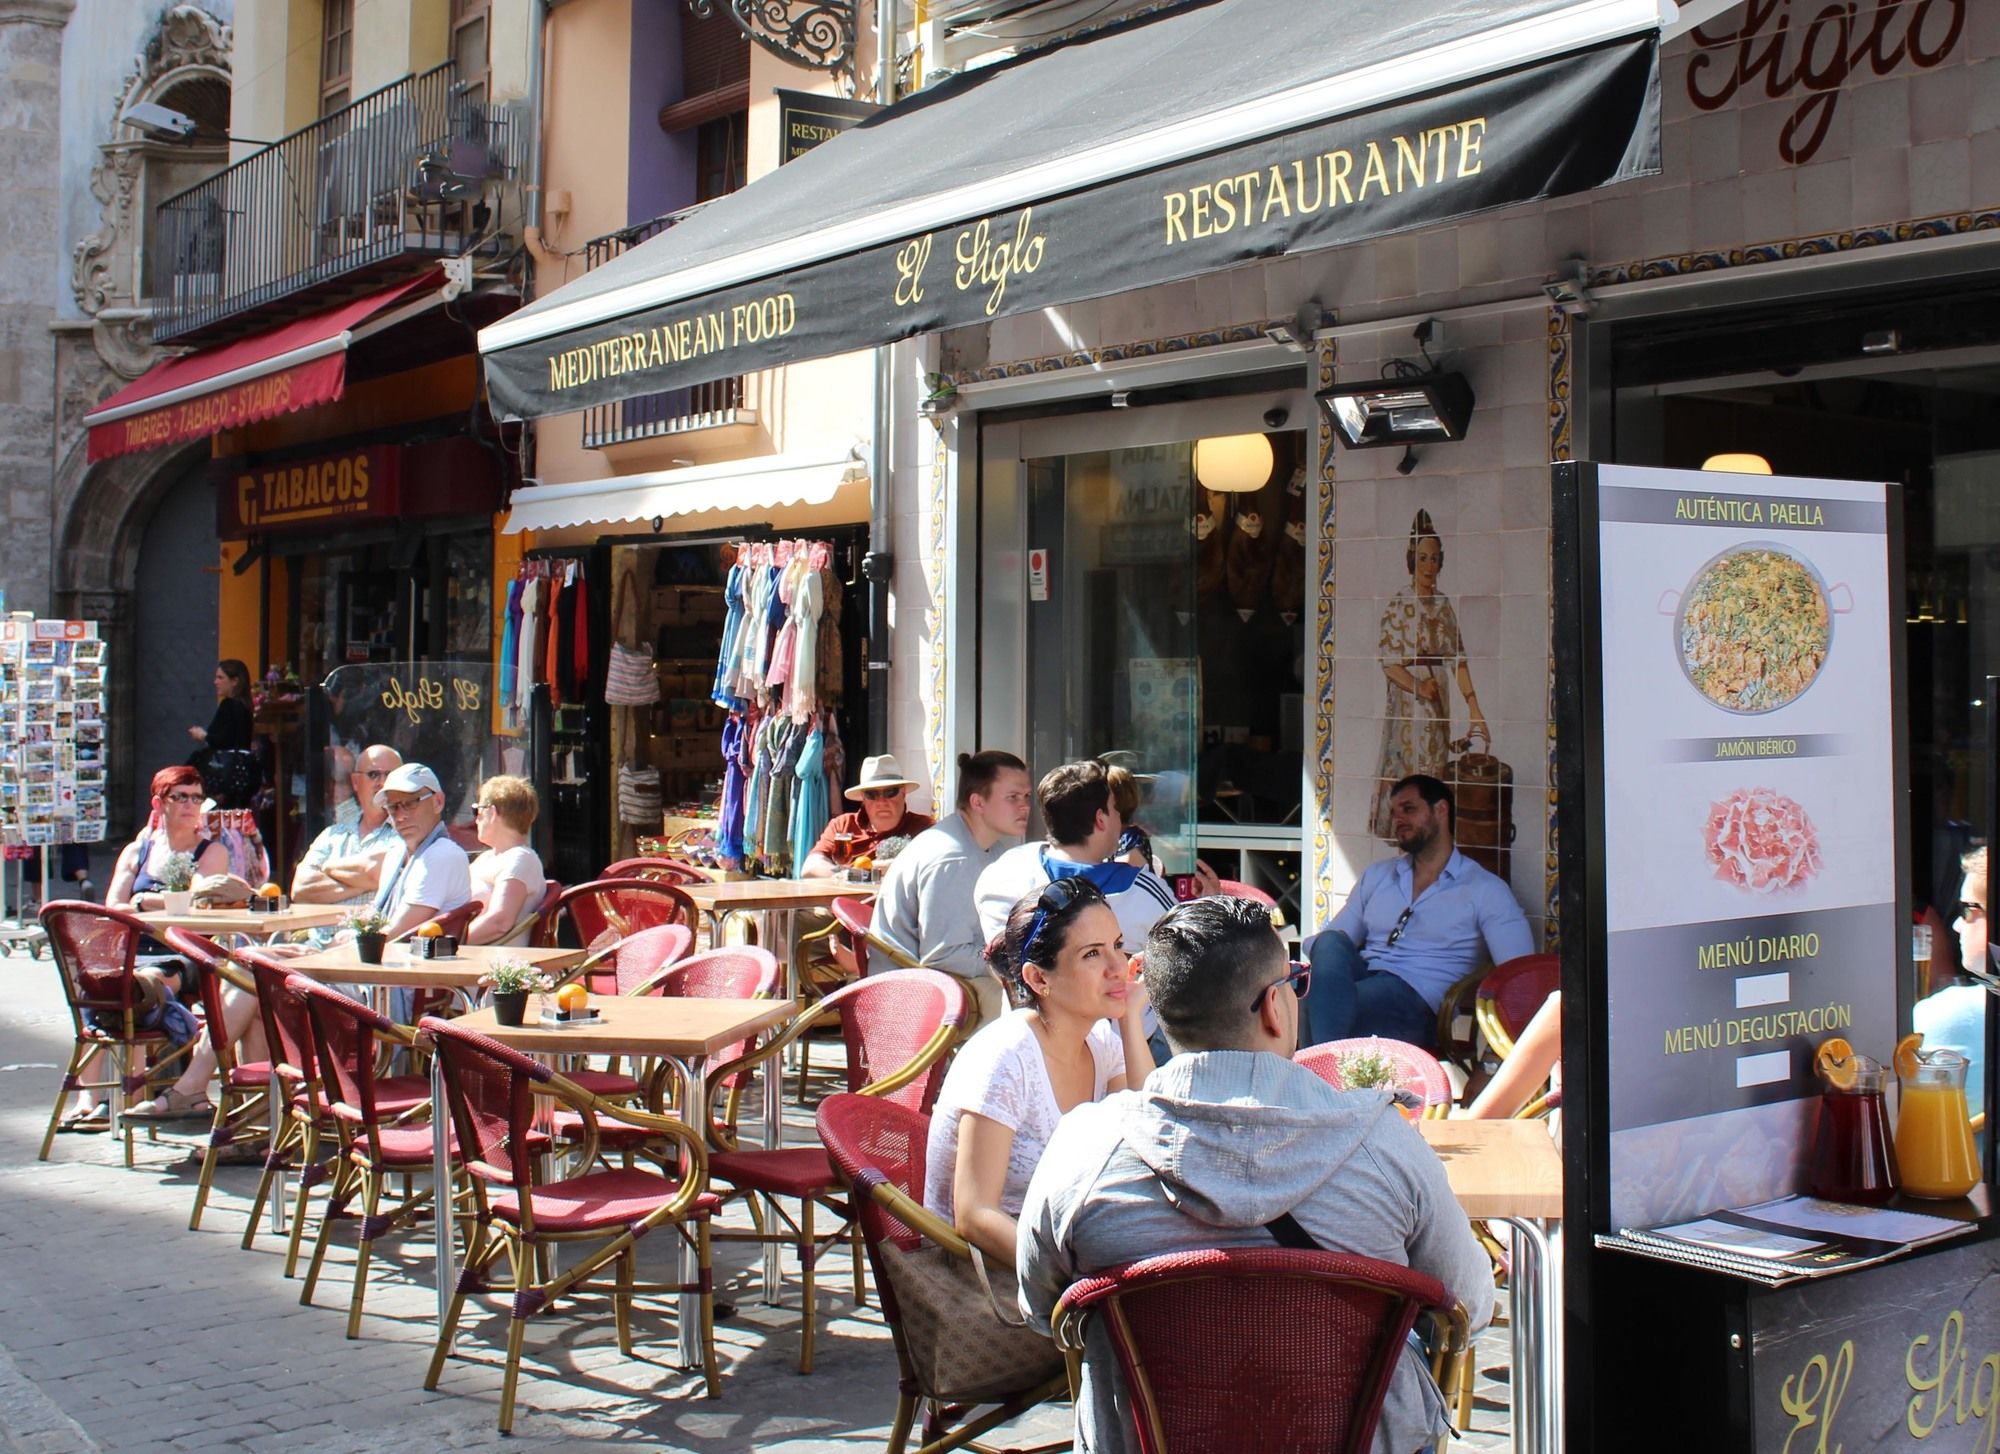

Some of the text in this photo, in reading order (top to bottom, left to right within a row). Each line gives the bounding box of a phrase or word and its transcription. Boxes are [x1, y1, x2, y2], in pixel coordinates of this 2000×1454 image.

[1163, 116, 1488, 246] RESTAURANTE
[894, 206, 1047, 316] El Siglo
[548, 293, 796, 392] MEDITERRANEAN FOOD
[125, 411, 172, 446] TIMBRES
[179, 395, 228, 433] TABACO
[238, 373, 293, 418] STAMPS
[263, 454, 369, 511] TABACOS
[1675, 496, 1824, 526] AUTÉNTICA PAELLA
[1715, 738, 1796, 757] JAMÓN IBÉRICO
[1698, 932, 1820, 970] MENÚ DIARIO
[1664, 1001, 1851, 1055] MENÚ DEGUSTACIÓN
[1780, 1340, 1854, 1454] El
